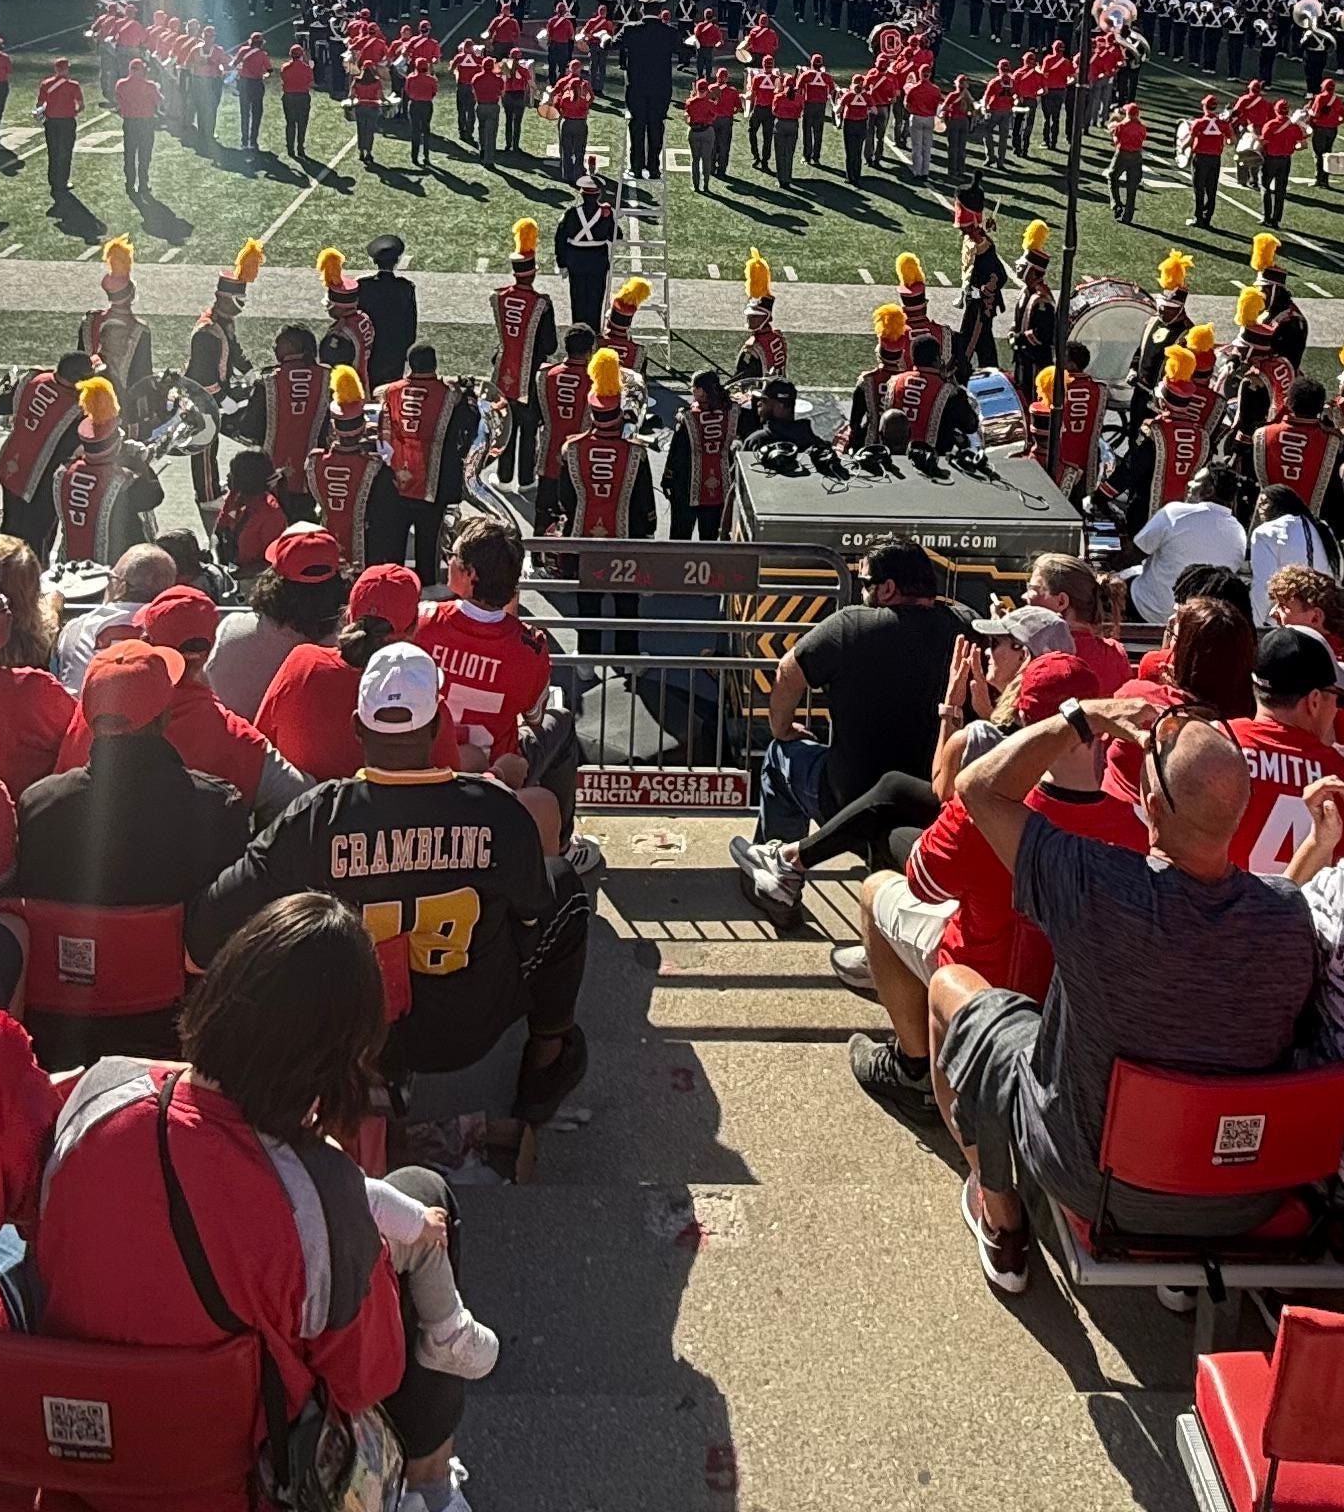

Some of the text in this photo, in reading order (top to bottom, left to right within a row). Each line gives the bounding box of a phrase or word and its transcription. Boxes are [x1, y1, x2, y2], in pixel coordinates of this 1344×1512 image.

[610, 559, 637, 582] 22
[684, 561, 710, 584] 20
[431, 643, 502, 684] ELLIOTT
[1246, 749, 1322, 787] SMITH
[583, 774, 734, 791] FIELD ACCESS IS
[574, 788, 743, 806] STRICTLY PROHIBITED
[330, 825, 493, 879] GRAMBLING
